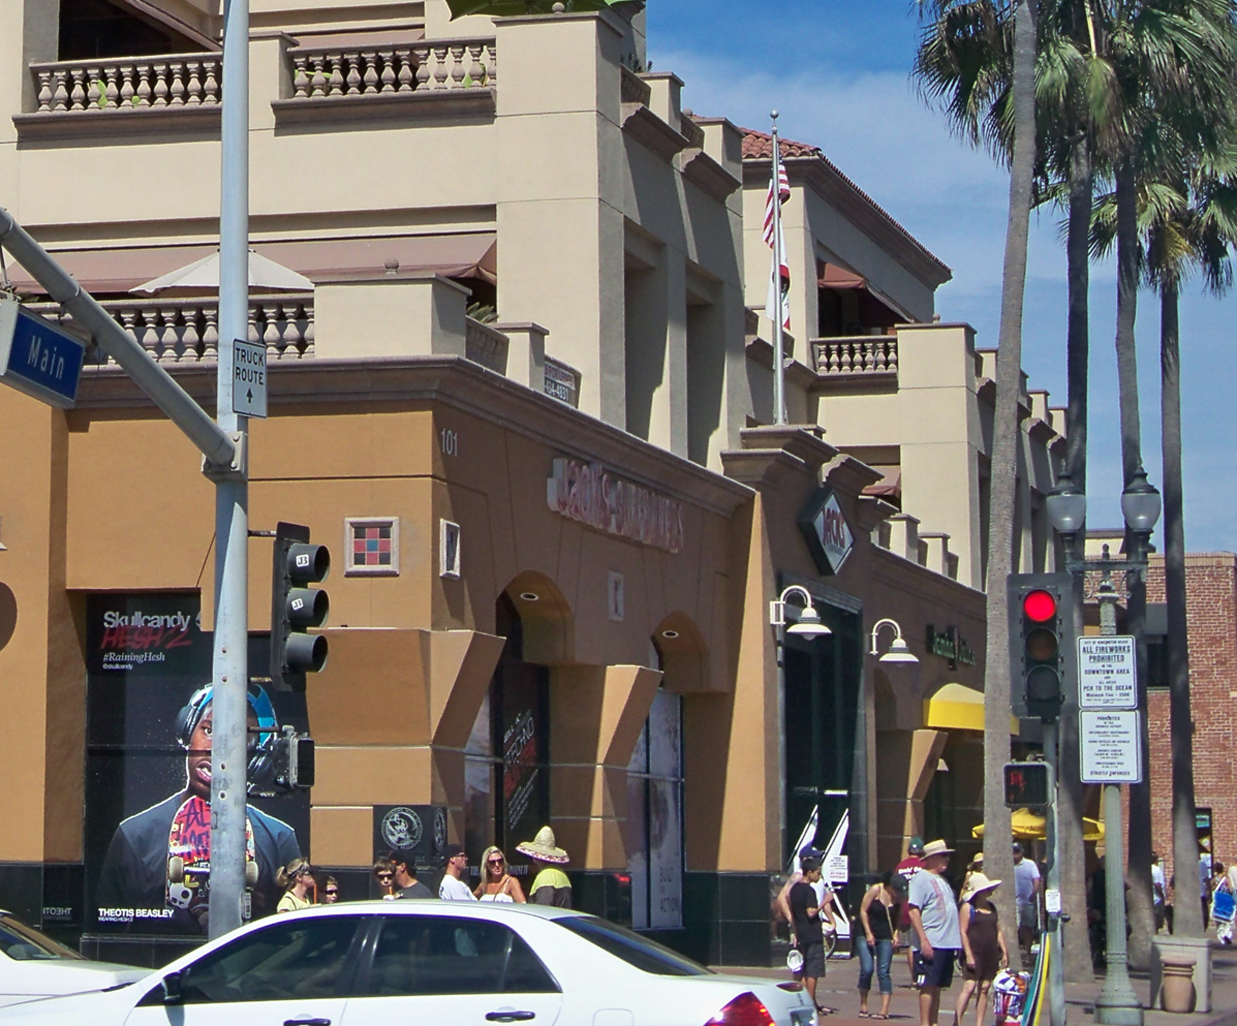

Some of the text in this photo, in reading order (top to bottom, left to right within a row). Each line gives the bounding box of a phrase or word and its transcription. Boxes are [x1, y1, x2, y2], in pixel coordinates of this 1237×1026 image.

[27, 335, 65, 380] Main
[235, 348, 264, 367] TRUCK
[235, 367, 264, 385] ROUTE
[441, 428, 458, 458] 101
[103, 611, 191, 631] Skullcandy
[165, 625, 192, 650] 2
[103, 652, 165, 663] #RainingHesh
[98, 908, 174, 918] THEOTIS BEASLEY
